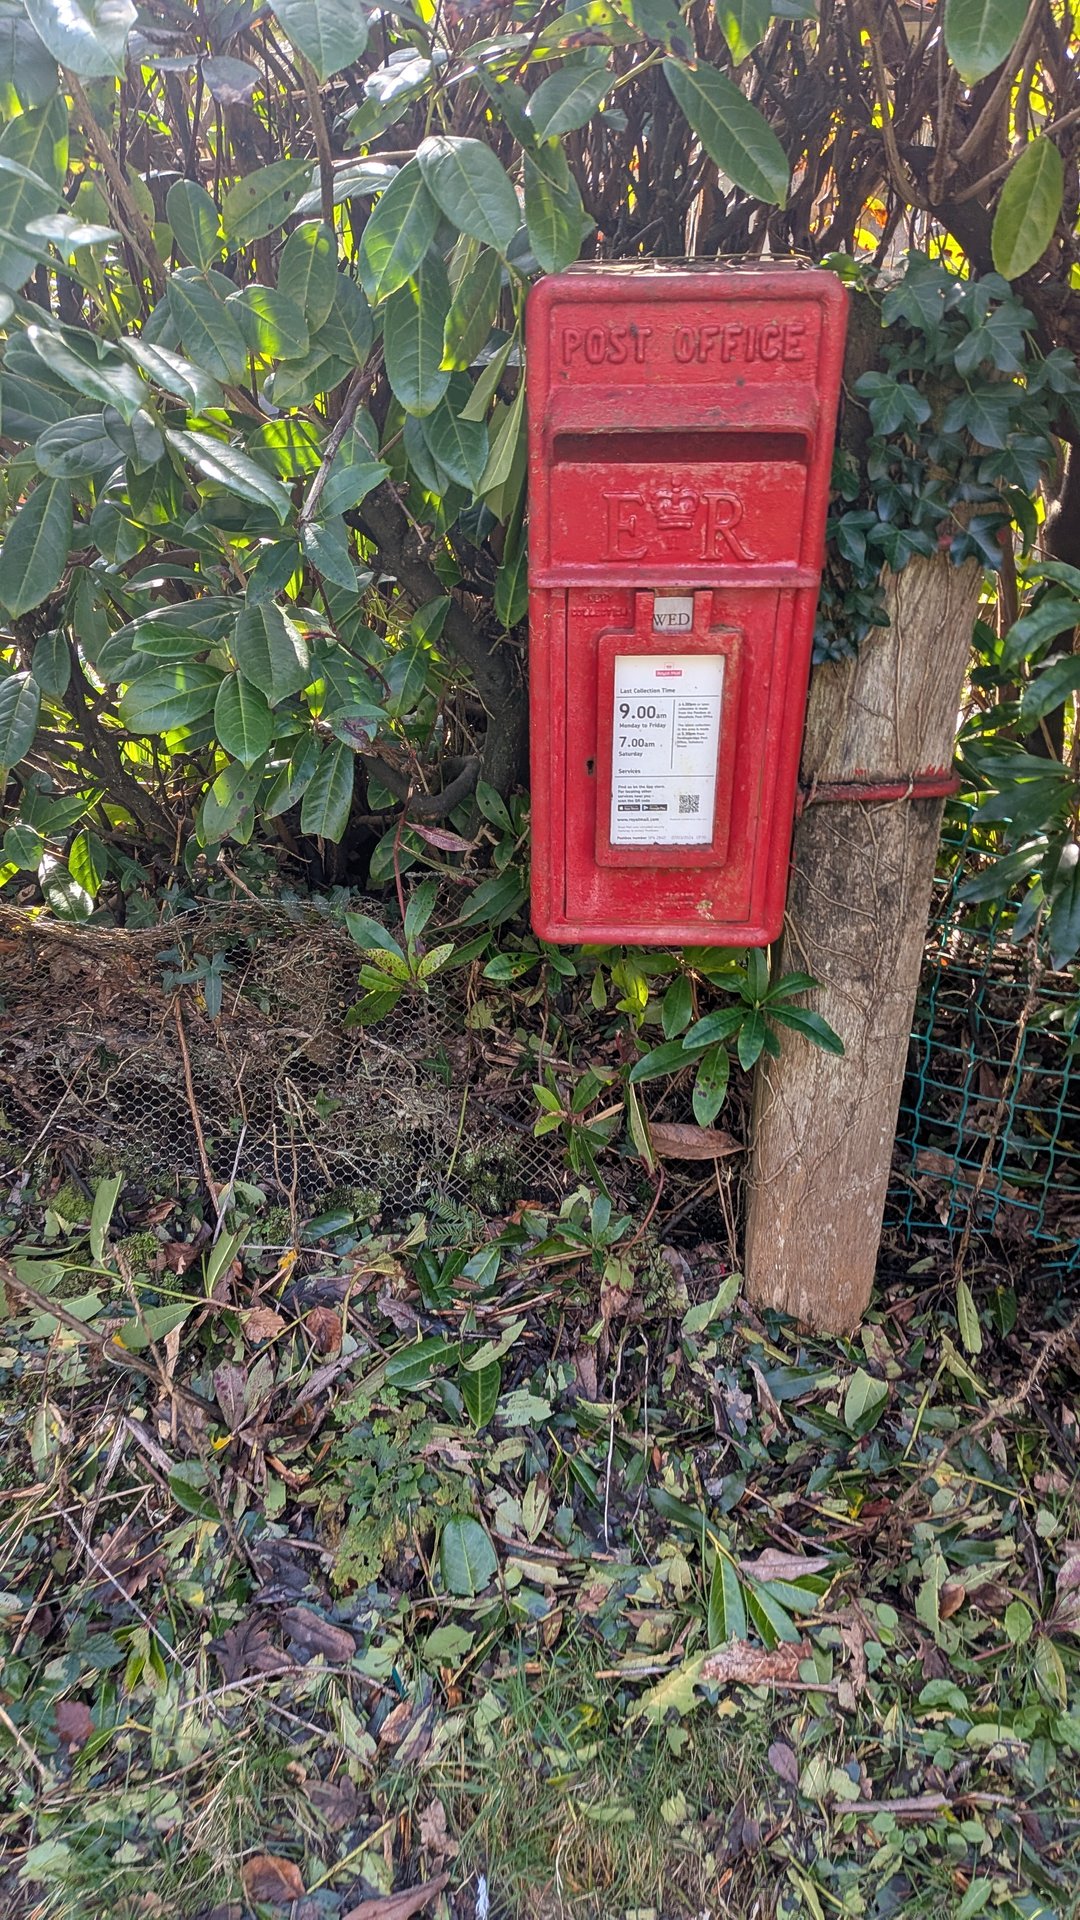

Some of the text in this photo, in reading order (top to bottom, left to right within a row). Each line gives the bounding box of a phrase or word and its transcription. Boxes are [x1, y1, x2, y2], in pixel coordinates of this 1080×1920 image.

[561, 323, 806, 365] POST OFFICE
[601, 492, 759, 561] E R
[653, 613, 690, 626] WED
[619, 703, 667, 719] 9.00am
[619, 736, 655, 747] 7.00am
